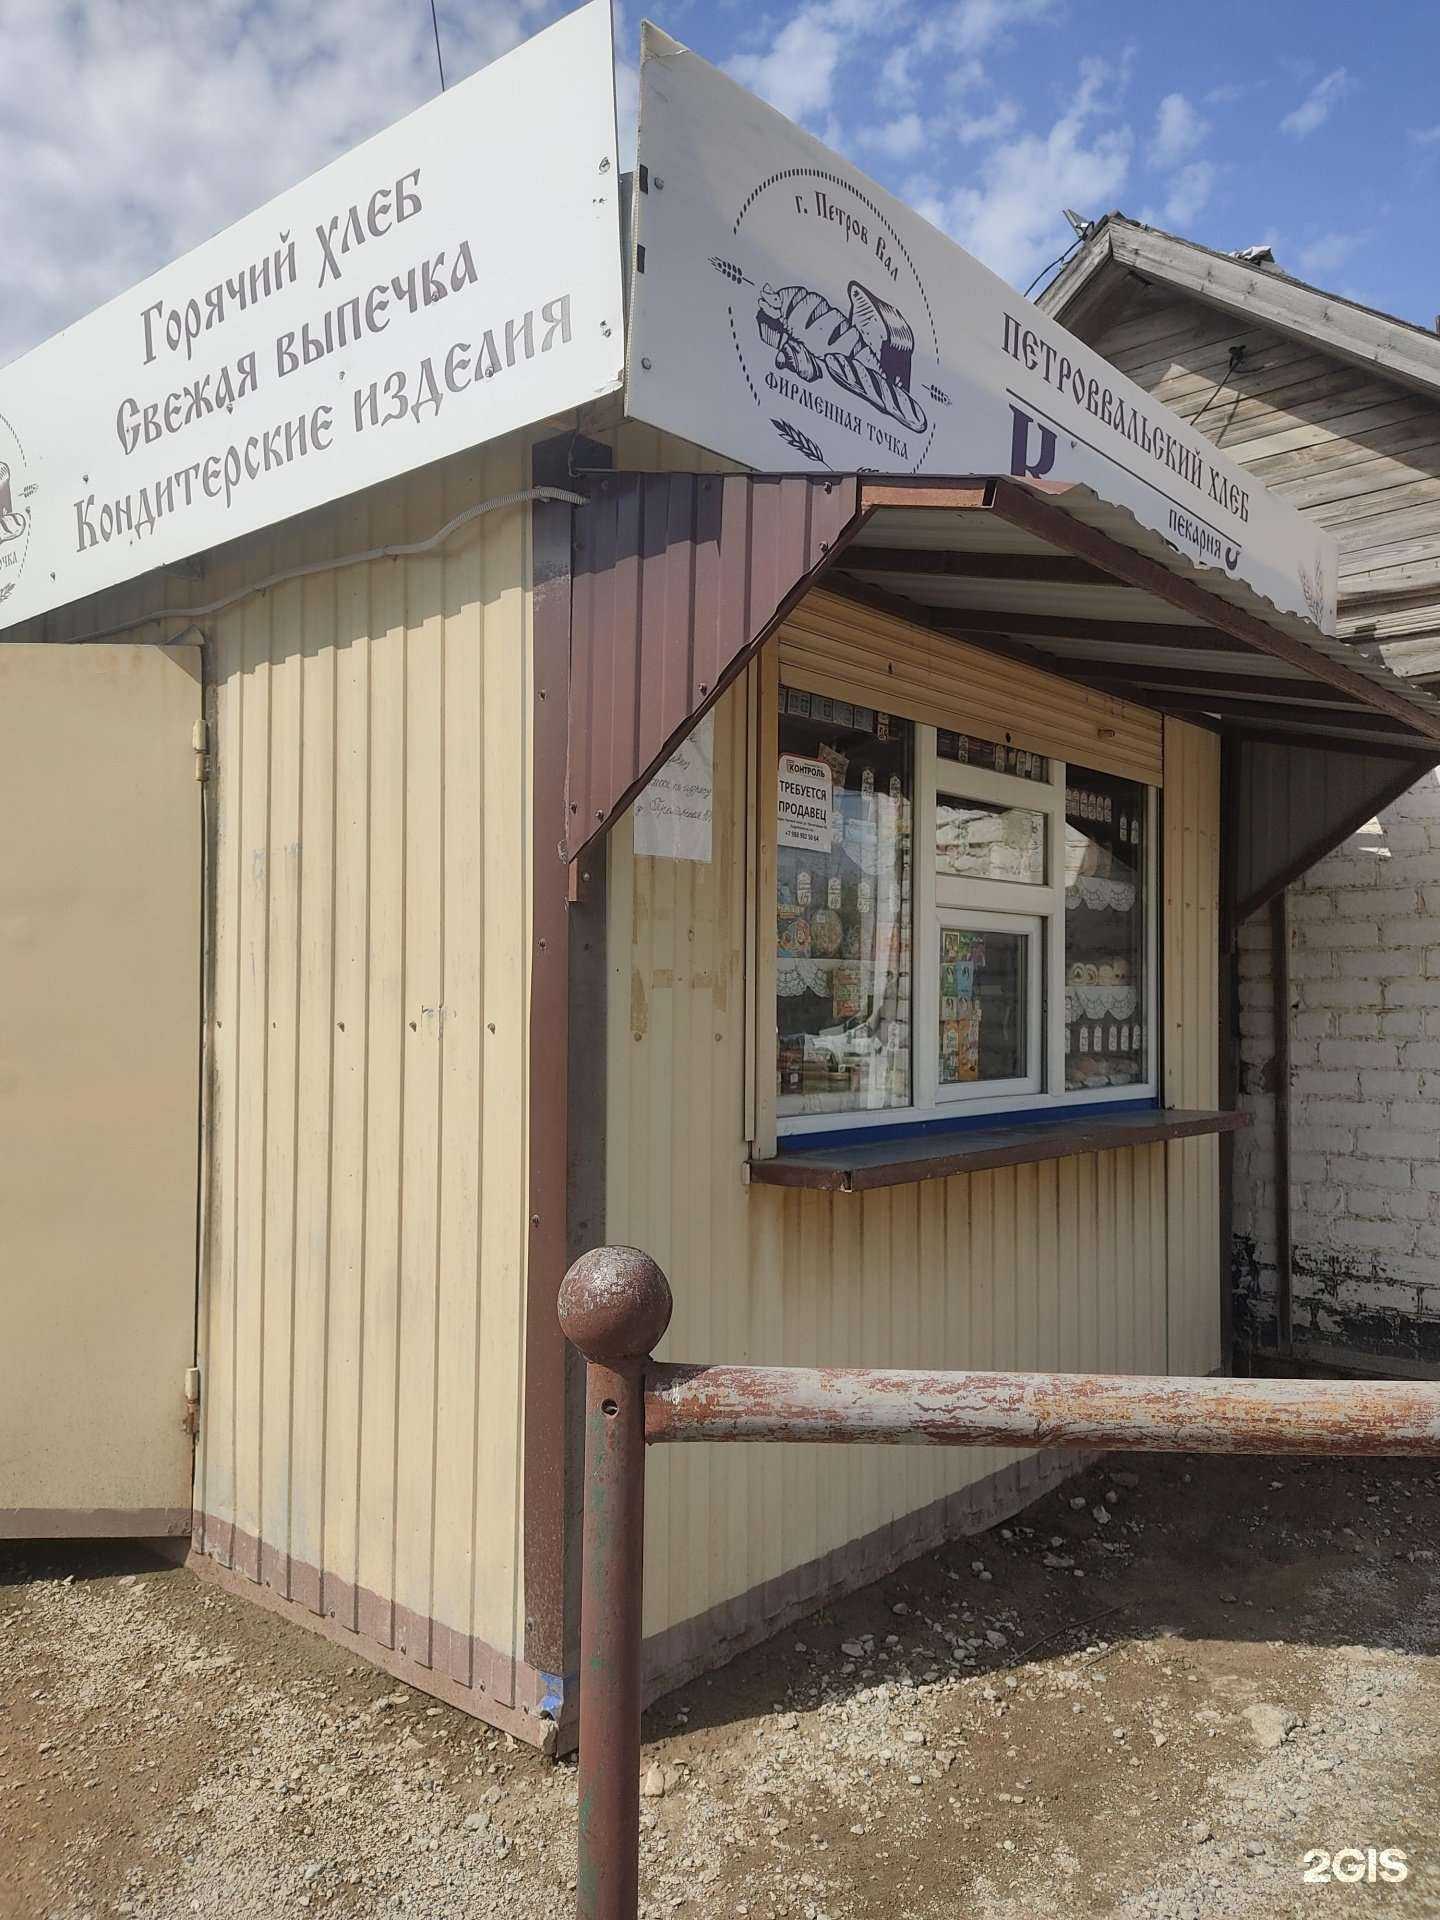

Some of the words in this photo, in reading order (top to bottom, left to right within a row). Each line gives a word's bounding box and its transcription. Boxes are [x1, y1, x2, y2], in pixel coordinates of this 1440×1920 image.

[815, 191, 868, 243] Петров
[876, 236, 898, 281] Вал
[116, 351, 258, 455] Свежая
[276, 240, 479, 378] выпечка
[140, 229, 297, 365] Горячий
[73, 405, 334, 553] Кондитерские
[354, 294, 573, 432] изделия
[1001, 311, 1203, 490] ПЕТРОВВАЛЬСКИЙ
[1207, 465, 1249, 523] ХЛЕБ
[778, 800, 827, 824] ПРОДАВЕЦ
[779, 780, 827, 801] ТРЕБУЕТСЯ
[789, 763, 826, 778] КОНТРОЛЬ
